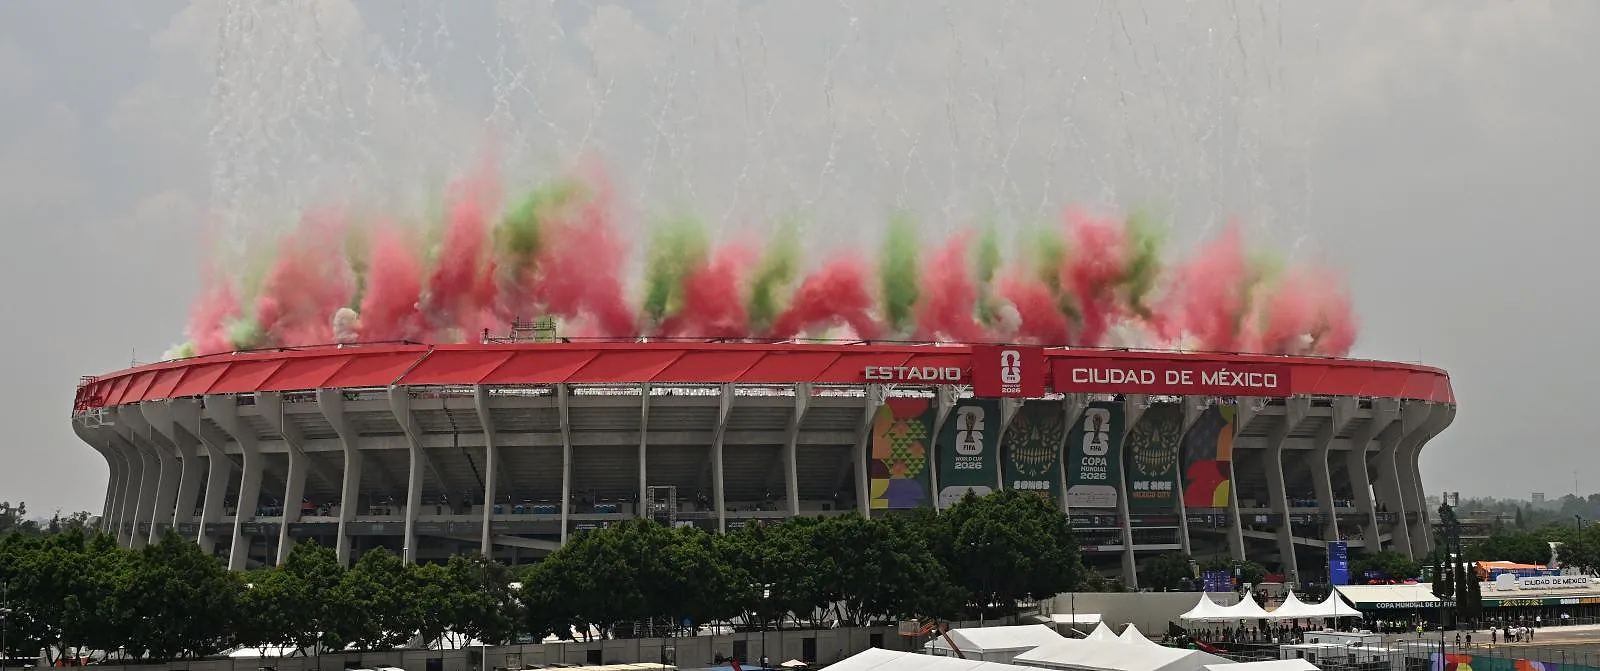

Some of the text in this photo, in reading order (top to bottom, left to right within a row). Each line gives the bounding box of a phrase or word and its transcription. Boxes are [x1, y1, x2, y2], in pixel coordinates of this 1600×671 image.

[865, 366, 961, 380] ESTADIO
[1072, 368, 1277, 388] CIUDAD DE MÉXICO
[954, 462, 983, 470] 2026
[1081, 457, 1107, 466] COPA
[1080, 472, 1107, 480] 2026
[1133, 480, 1172, 491] WE ARE
